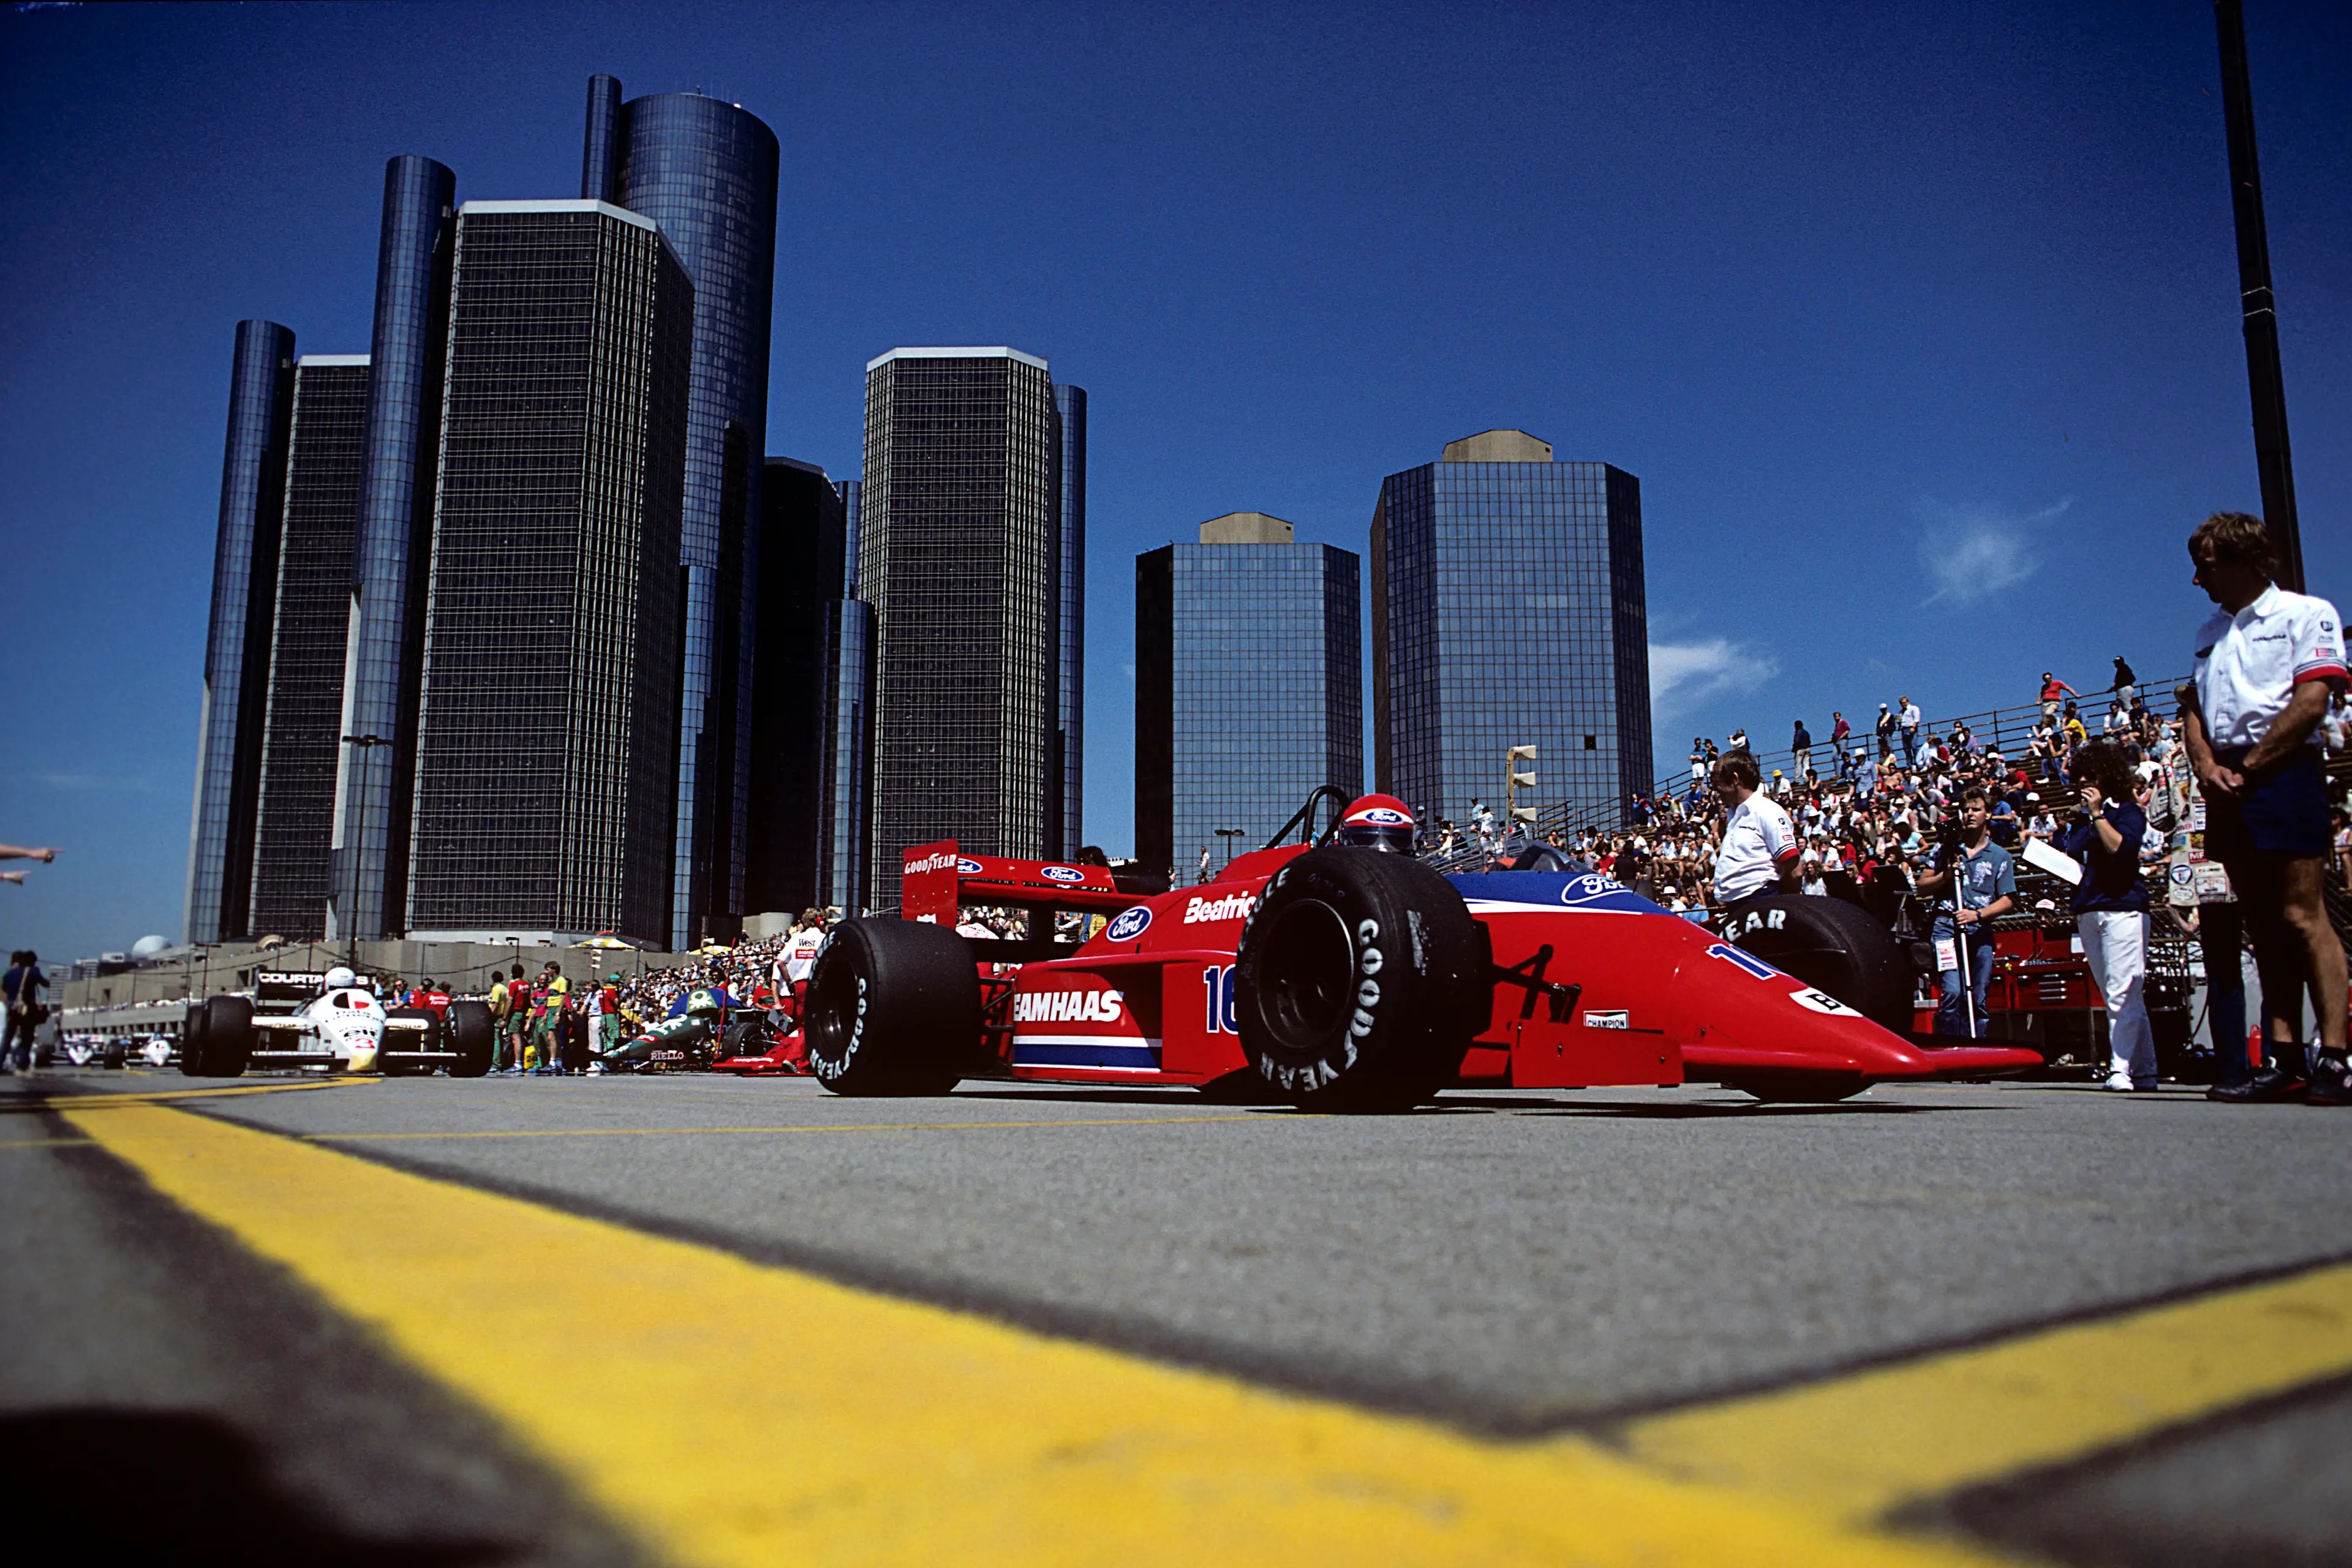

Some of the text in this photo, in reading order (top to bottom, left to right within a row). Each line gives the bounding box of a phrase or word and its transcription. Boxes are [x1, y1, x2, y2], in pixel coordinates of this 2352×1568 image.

[1371, 810, 1396, 821] Ford
[904, 853, 957, 875] GOODYEAR
[957, 861, 974, 871] ord
[1050, 868, 1076, 880] Ford
[1183, 890, 1257, 924] Beatric
[1112, 910, 1145, 938] Ford
[1718, 909, 1787, 942] EAR
[799, 938, 816, 948] West
[258, 973, 369, 985] COURTAS
[1013, 990, 1125, 1022] EAMHAAS
[1259, 918, 1384, 1092] GOODYEAR
[809, 978, 867, 1080] GOODYEAR
[1588, 1019, 1625, 1029] CHAMPION
[650, 1051, 685, 1060] RIELLO
